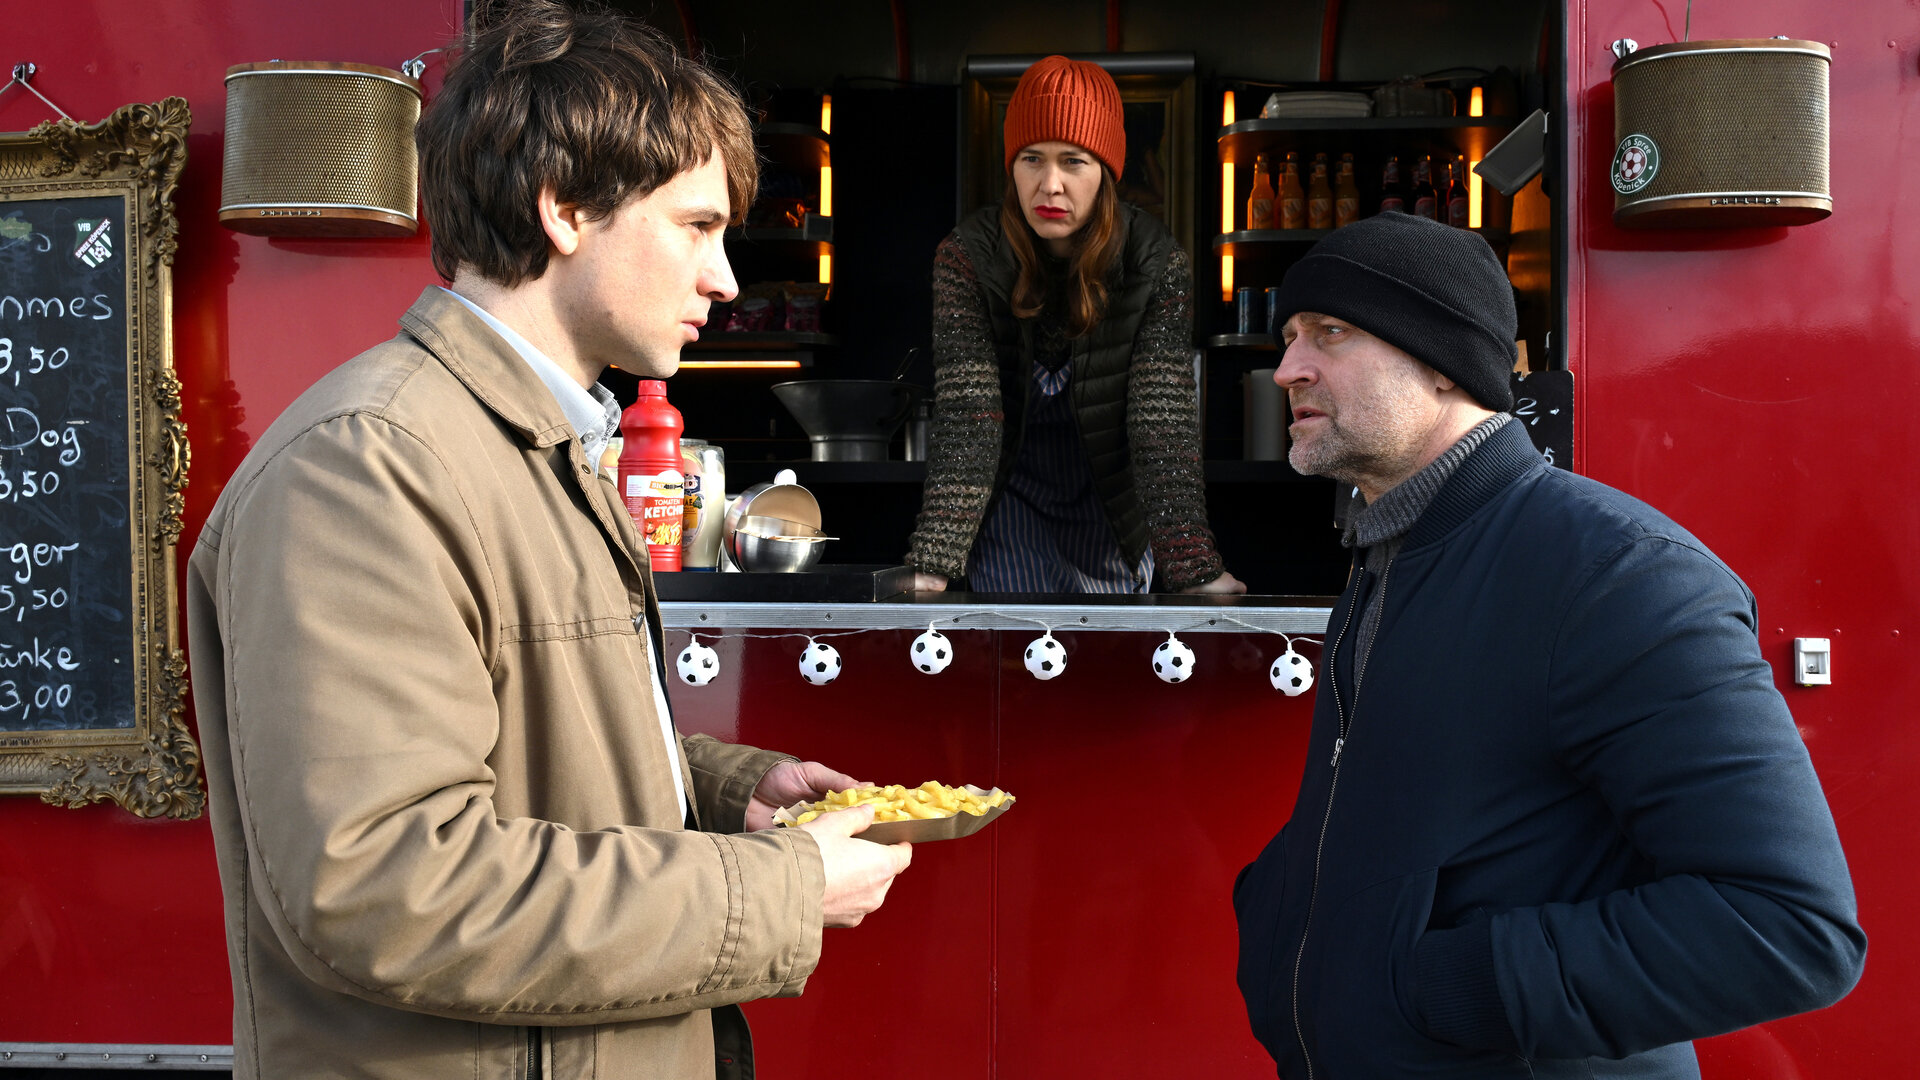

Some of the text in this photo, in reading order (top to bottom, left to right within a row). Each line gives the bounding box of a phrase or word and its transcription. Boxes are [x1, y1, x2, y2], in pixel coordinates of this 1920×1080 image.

[1634, 138, 1652, 155] Spree
[1711, 197, 1781, 206] PHILIPS
[260, 209, 321, 217] PHILIPS
[77, 222, 92, 232] VfB
[654, 498, 681, 506] TOMATEN
[0, 541, 80, 585] ger
